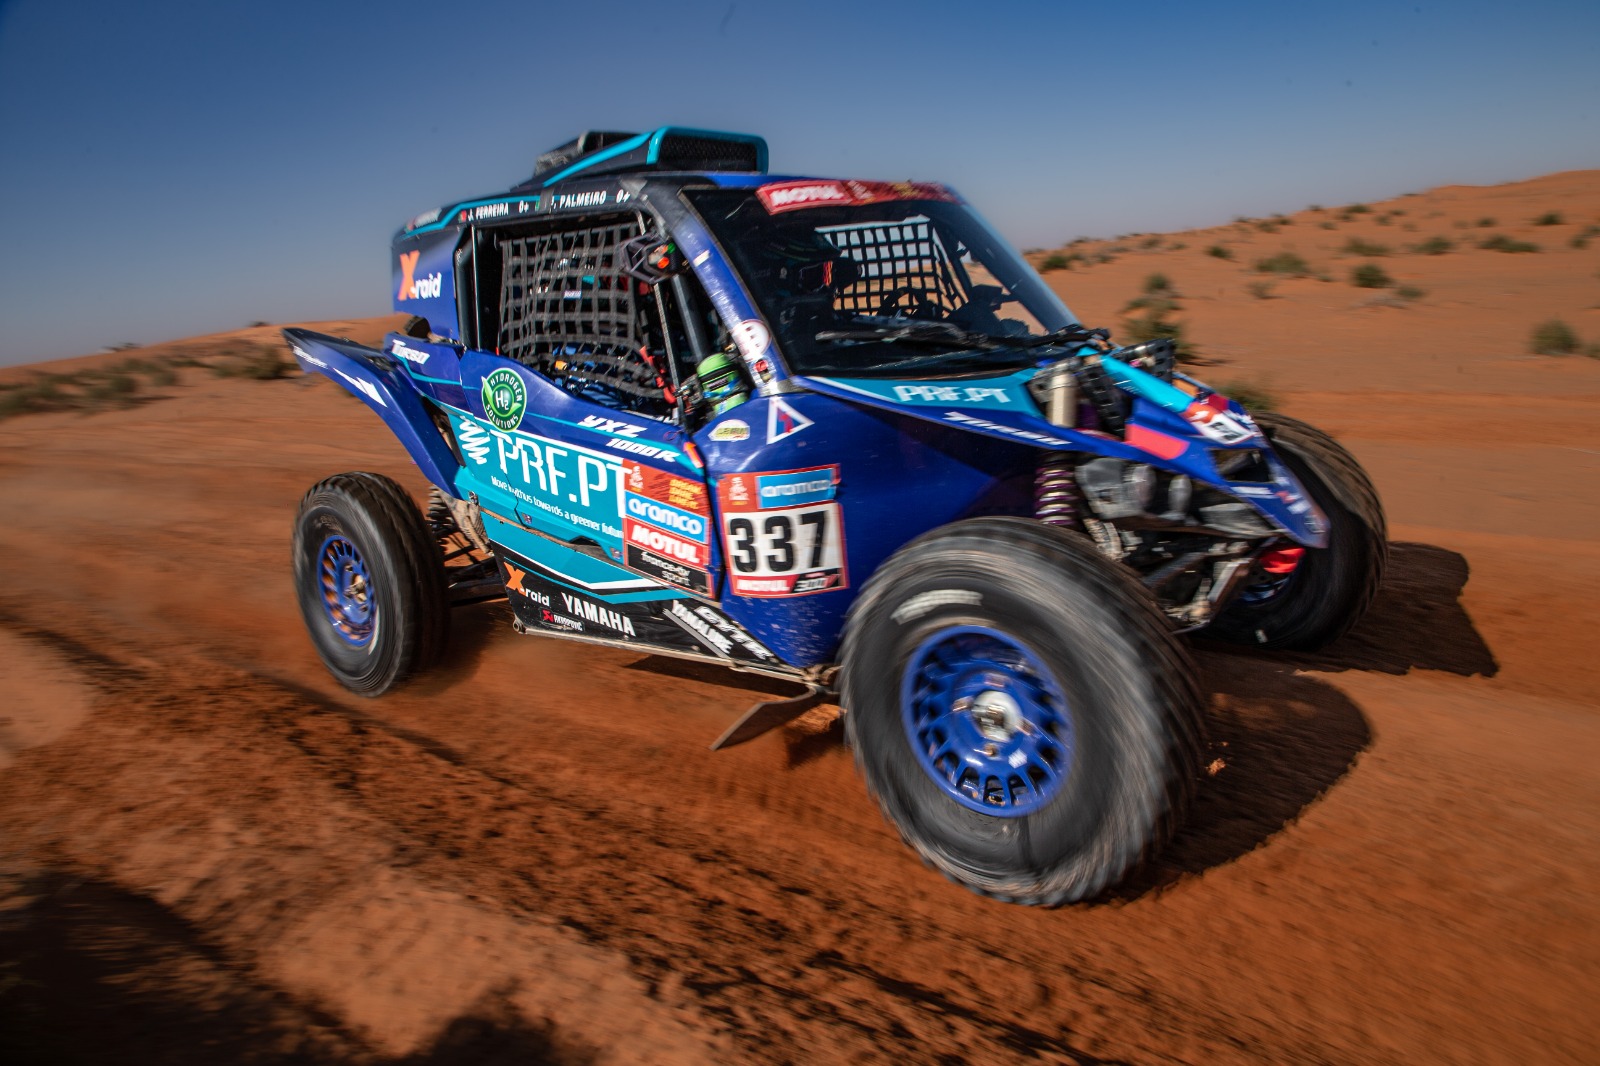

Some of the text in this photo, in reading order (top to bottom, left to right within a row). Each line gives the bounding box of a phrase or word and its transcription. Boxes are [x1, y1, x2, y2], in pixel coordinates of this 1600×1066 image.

[476, 202, 508, 220] FERREIRA
[560, 191, 606, 208] PALMEIRO
[490, 372, 523, 402] HYDROGEN
[893, 385, 1011, 403] PRF.PT
[486, 404, 519, 429] SOLUTIONS
[577, 415, 648, 438] YXZ
[606, 438, 680, 462] 1000R
[490, 430, 632, 518] PRF.PT
[533, 496, 563, 516] towards
[570, 513, 600, 531] greener
[628, 498, 702, 535] aramco
[632, 525, 700, 563] MOTUL
[729, 510, 827, 573] 337
[561, 592, 636, 637] YAMAHA
